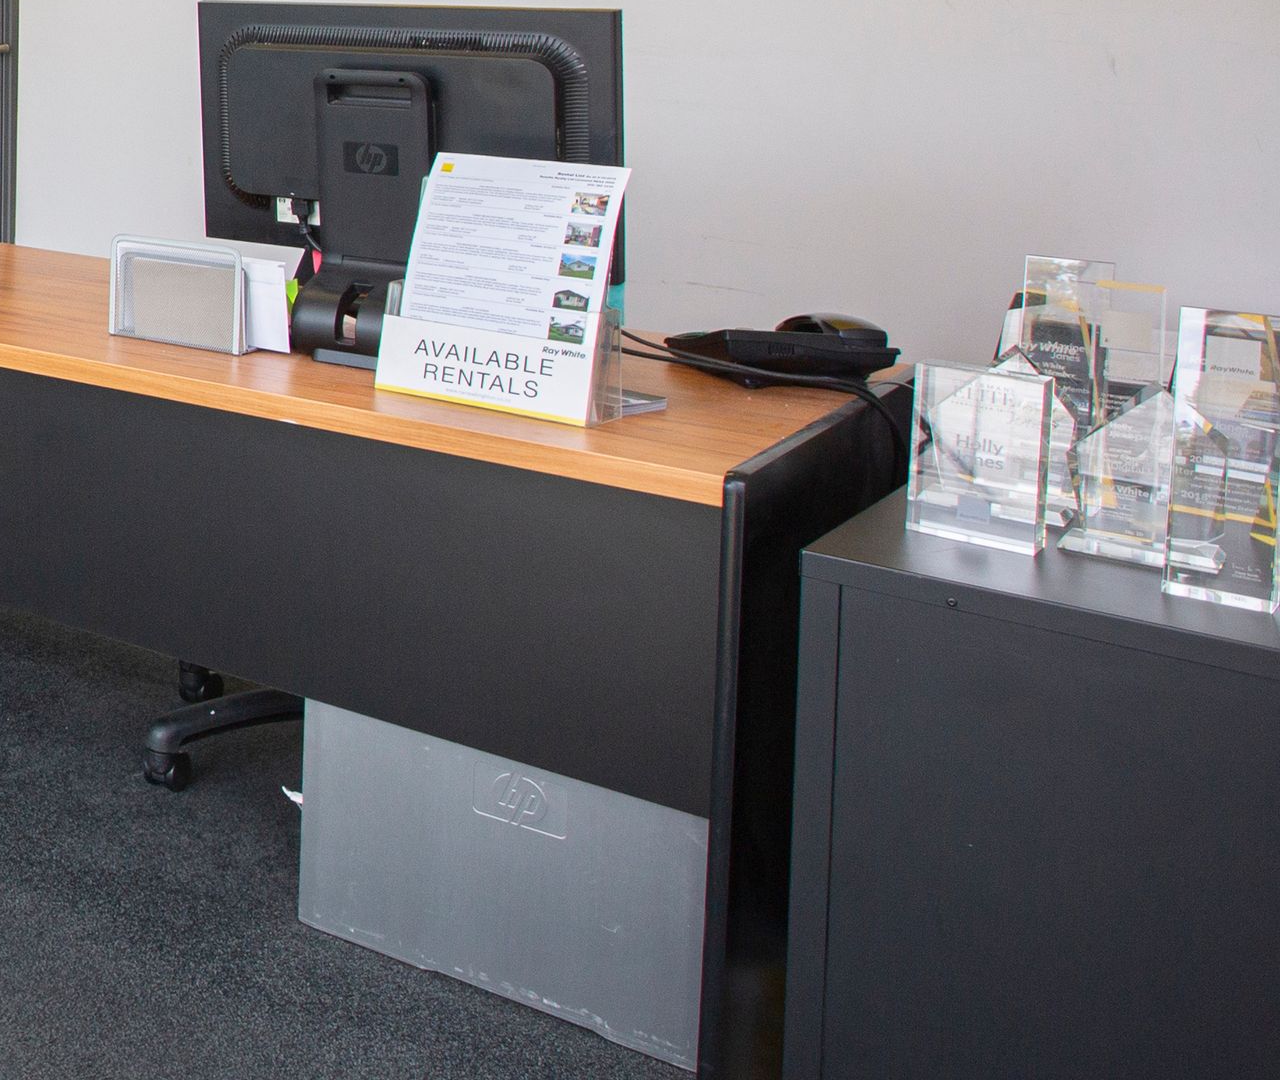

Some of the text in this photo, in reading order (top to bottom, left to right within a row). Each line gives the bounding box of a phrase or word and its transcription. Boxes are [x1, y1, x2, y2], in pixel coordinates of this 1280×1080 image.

[414, 339, 555, 377] AVAILABLE
[541, 346, 586, 360] Ray White
[423, 362, 539, 399] RENTALS
[956, 433, 1004, 456] Holly
[497, 770, 542, 826] hp
